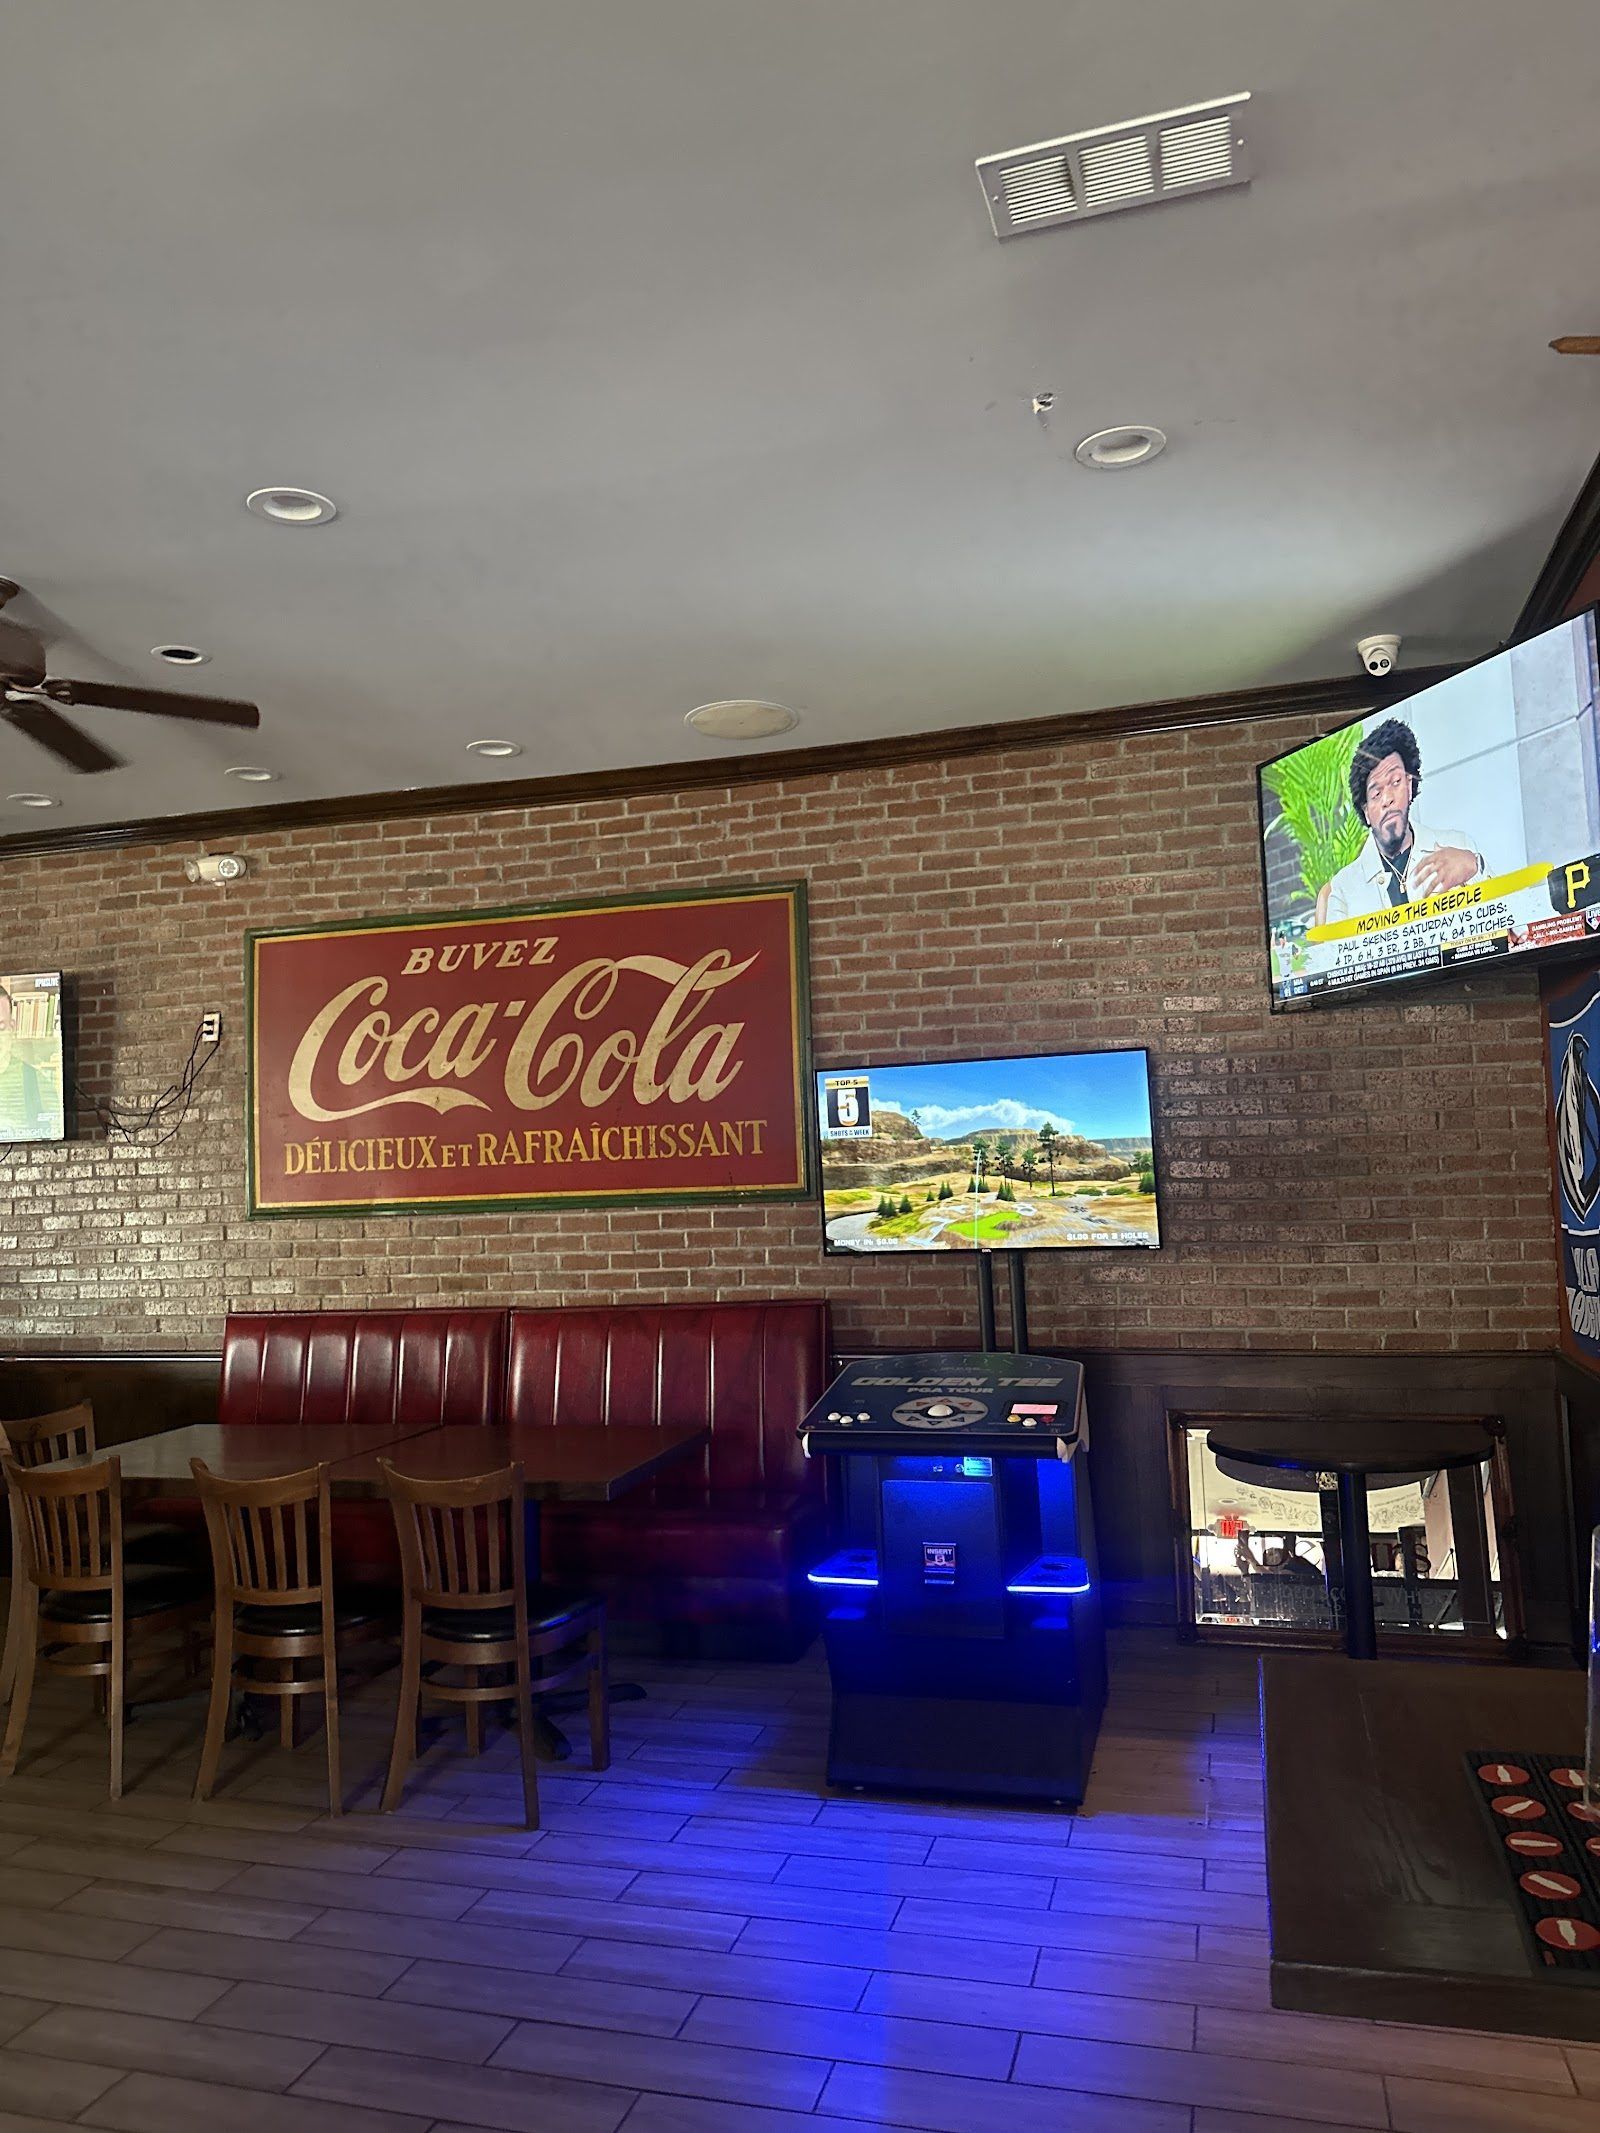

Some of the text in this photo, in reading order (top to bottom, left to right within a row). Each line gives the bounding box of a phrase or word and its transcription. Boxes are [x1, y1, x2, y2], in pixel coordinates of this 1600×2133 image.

[1565, 861, 1590, 909] P
[1338, 902, 1508, 954] PAUL SKENES SATURDAY VS CUBS:
[1356, 887, 1482, 934] MOVING THE NEEDLE
[1531, 915, 1582, 932] GAMBLING PROBLEM?
[400, 936, 560, 976] BUVEZ
[1335, 956, 1342, 966] 4
[1358, 952, 1364, 962] 6
[1378, 948, 1384, 957] 3
[1403, 941, 1410, 950] 2
[1430, 936, 1436, 945] 7
[1452, 926, 1465, 939] 84
[1469, 915, 1516, 935] PITCHES
[288, 948, 762, 1122] Coca-Cola
[285, 1120, 768, 1176] DÉLICIEUX ET RAFRAÎCHISSANT
[833, 1239, 861, 1247] MONEY
[1091, 1232, 1109, 1240] FOR
[1120, 1231, 1149, 1239] HOLES
[850, 1377, 1064, 1387] GOLDEN TEE
